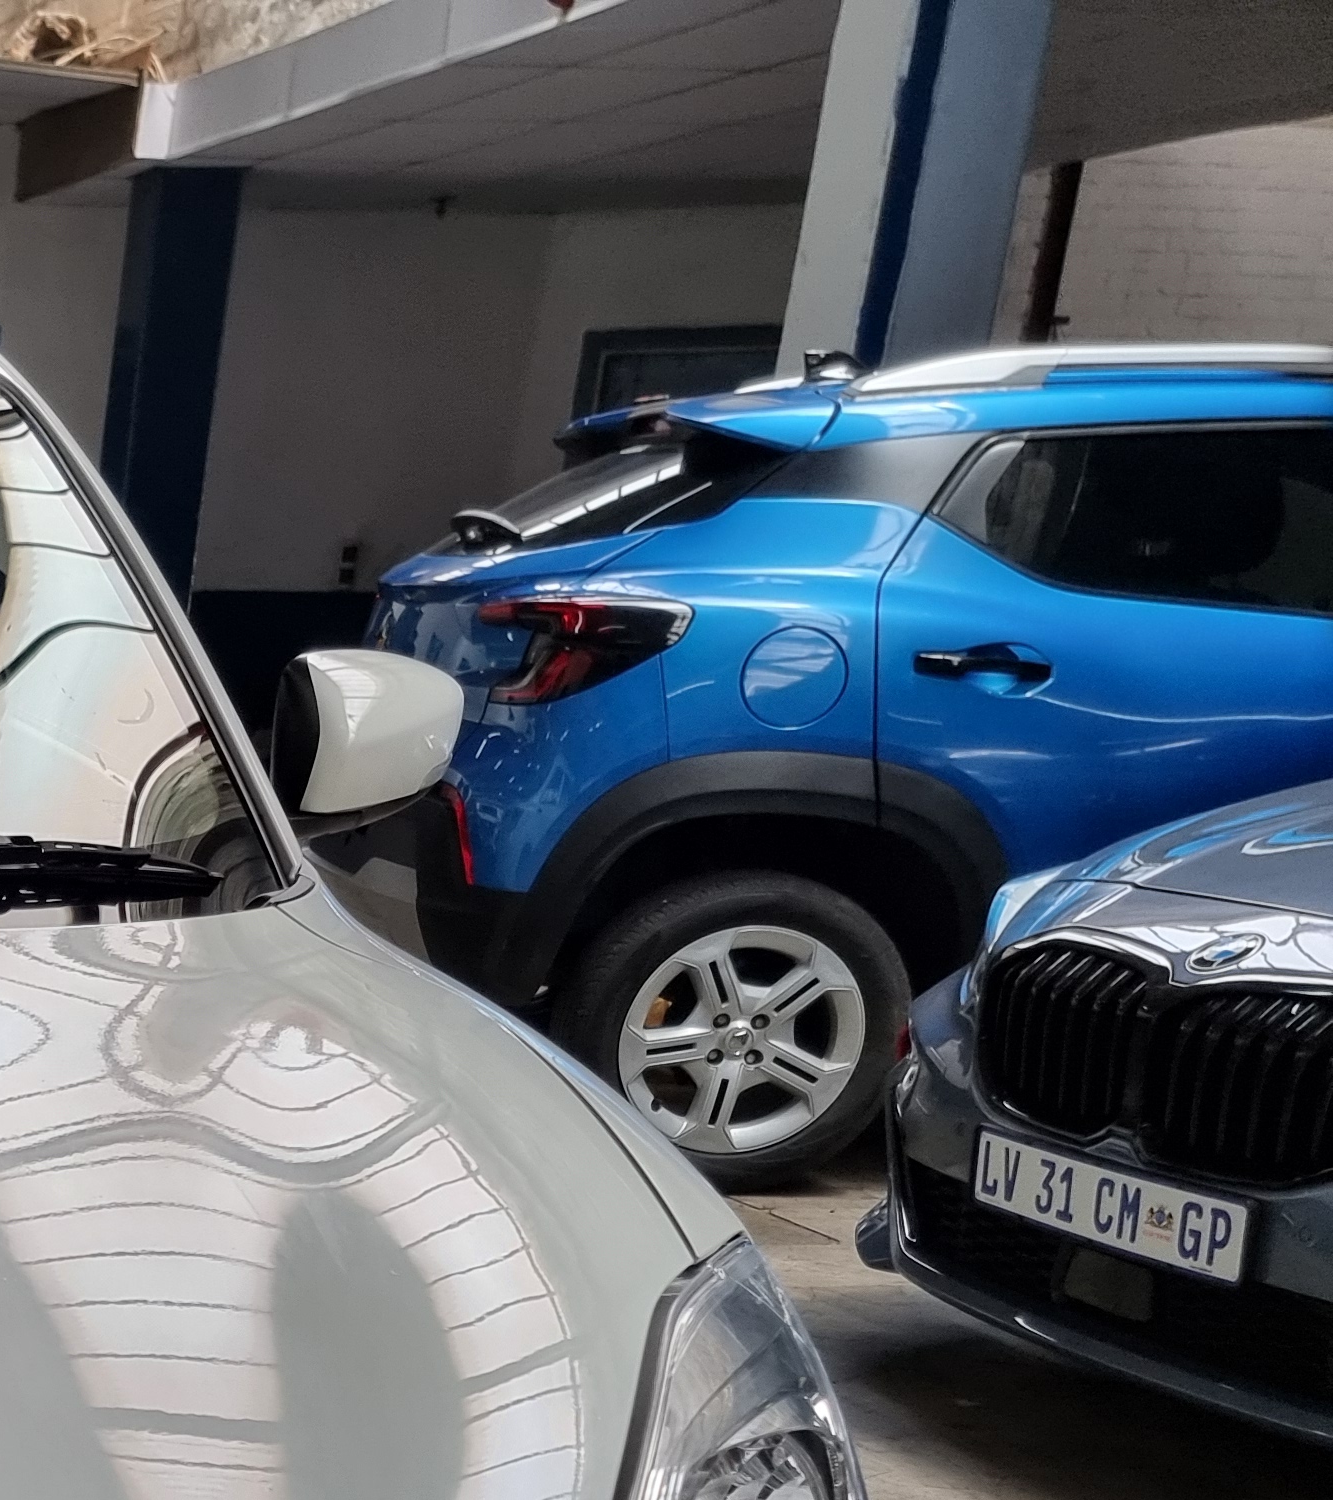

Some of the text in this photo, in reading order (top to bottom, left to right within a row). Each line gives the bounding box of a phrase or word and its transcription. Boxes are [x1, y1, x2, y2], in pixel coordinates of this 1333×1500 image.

[980, 1140, 1232, 1267] LV 31 CM GP
